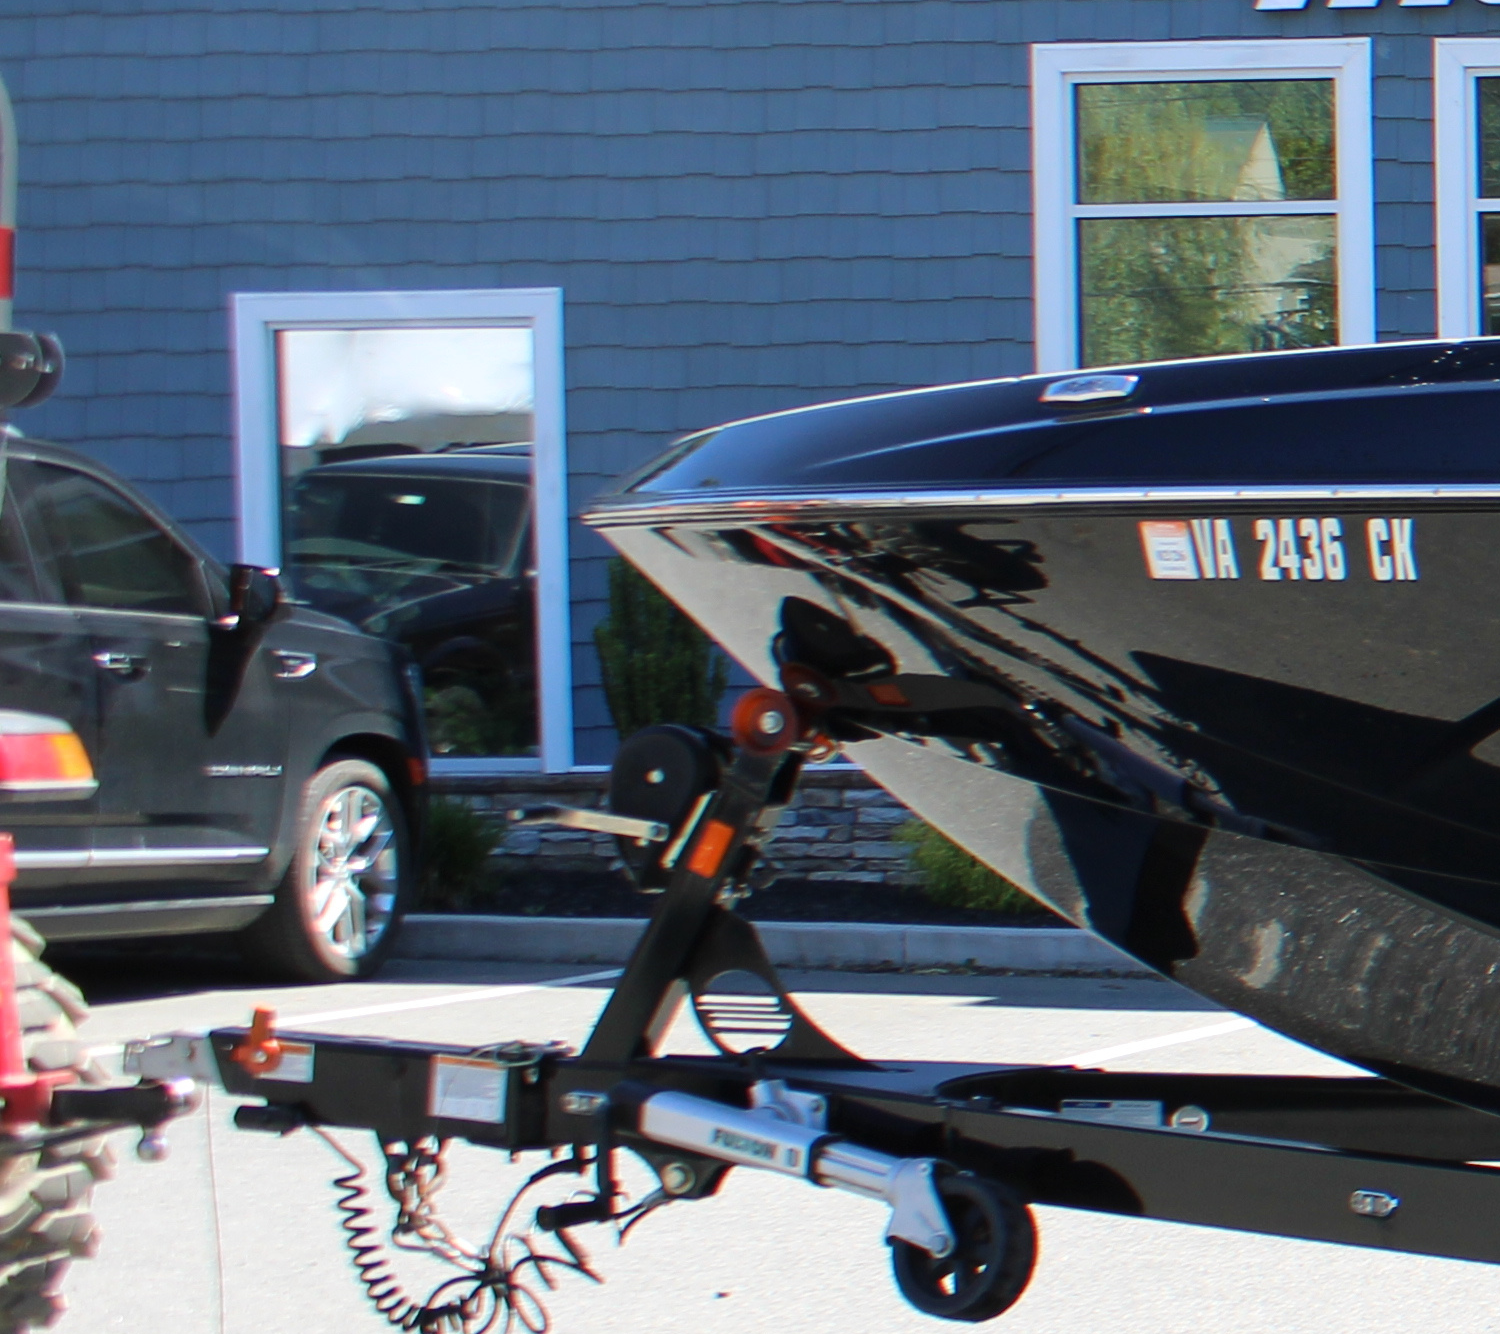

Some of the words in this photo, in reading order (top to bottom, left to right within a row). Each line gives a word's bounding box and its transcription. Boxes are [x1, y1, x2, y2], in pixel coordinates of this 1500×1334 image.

[1188, 517, 1241, 580] VA
[1253, 516, 1348, 581] 2436
[1366, 517, 1419, 581] CK
